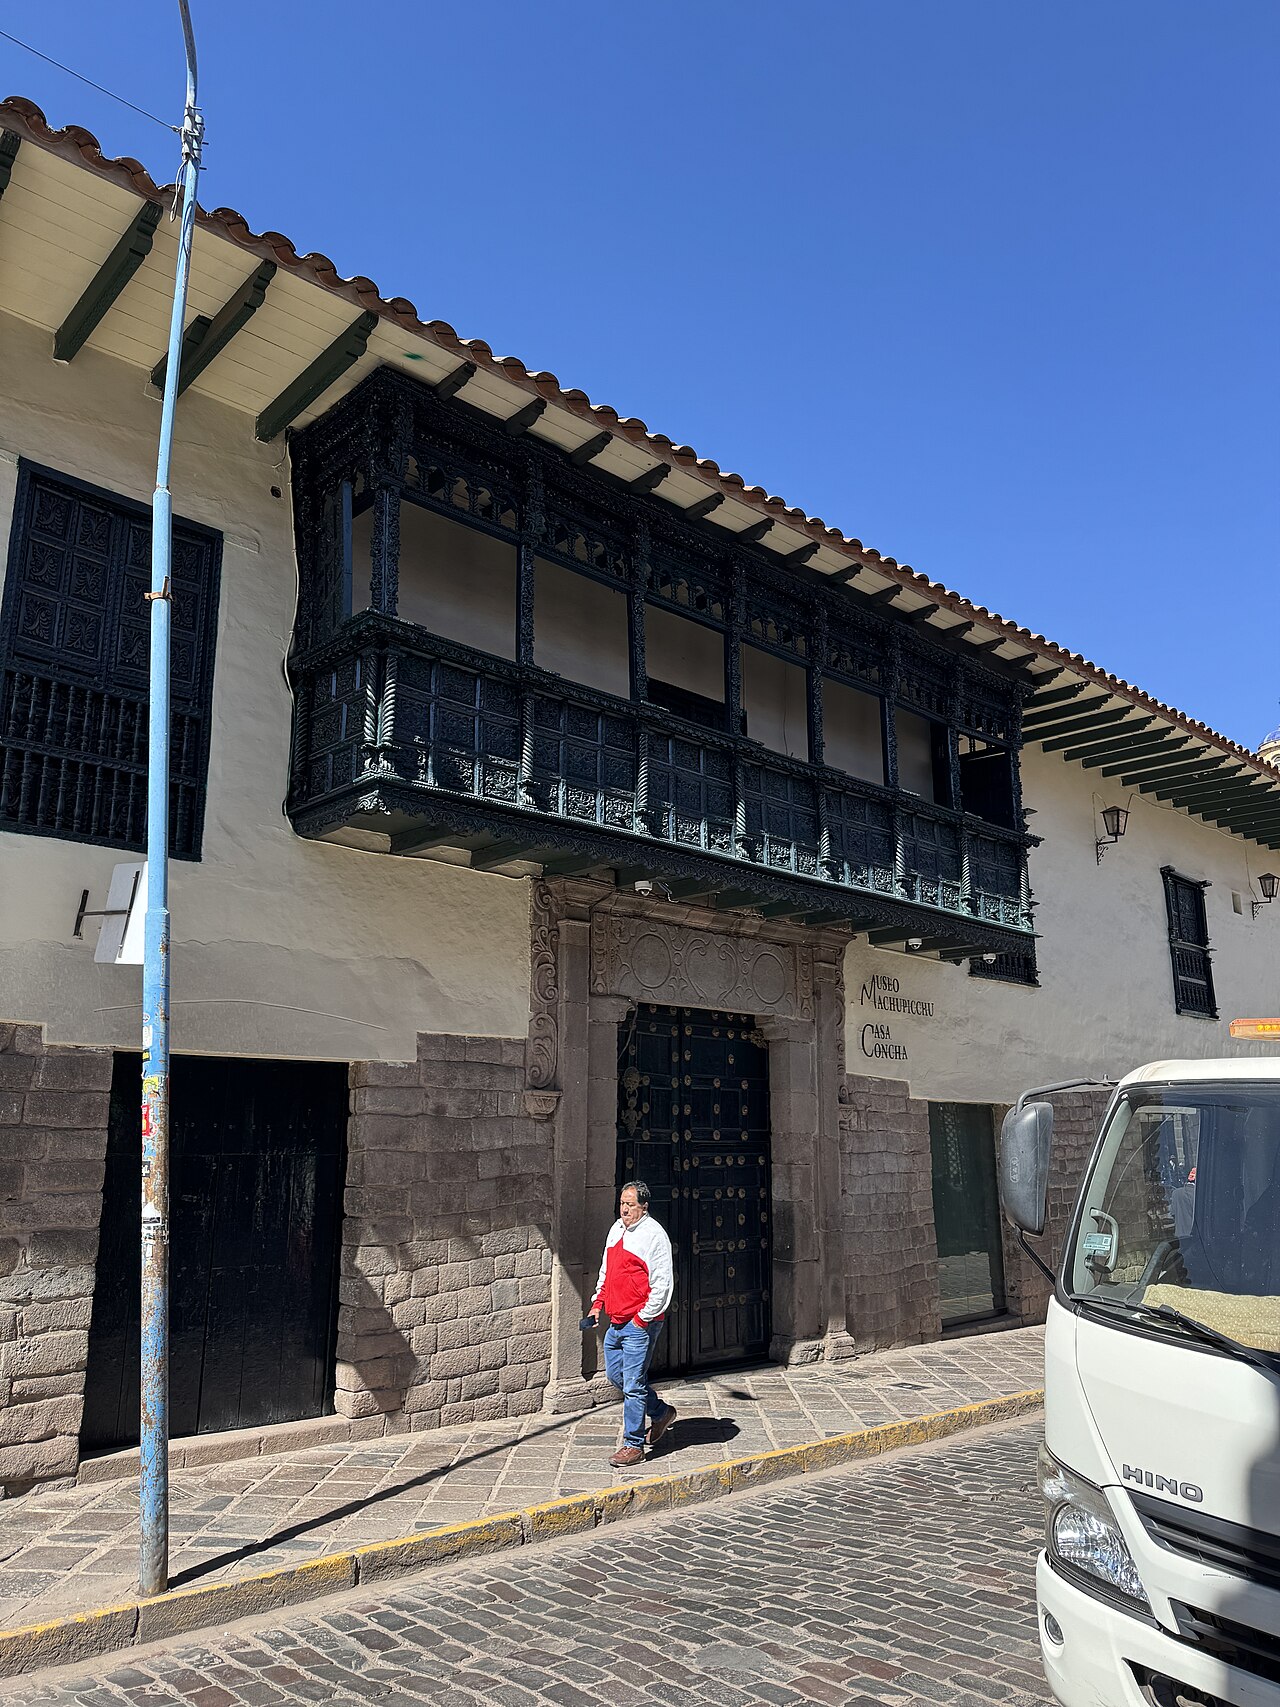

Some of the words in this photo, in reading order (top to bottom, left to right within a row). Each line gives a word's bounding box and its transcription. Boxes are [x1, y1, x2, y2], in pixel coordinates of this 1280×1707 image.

[860, 974, 900, 1009] MUSEO
[861, 1023, 891, 1058] CASA
[861, 1023, 908, 1060] CONCHA
[1122, 1463, 1204, 1503] HINO
